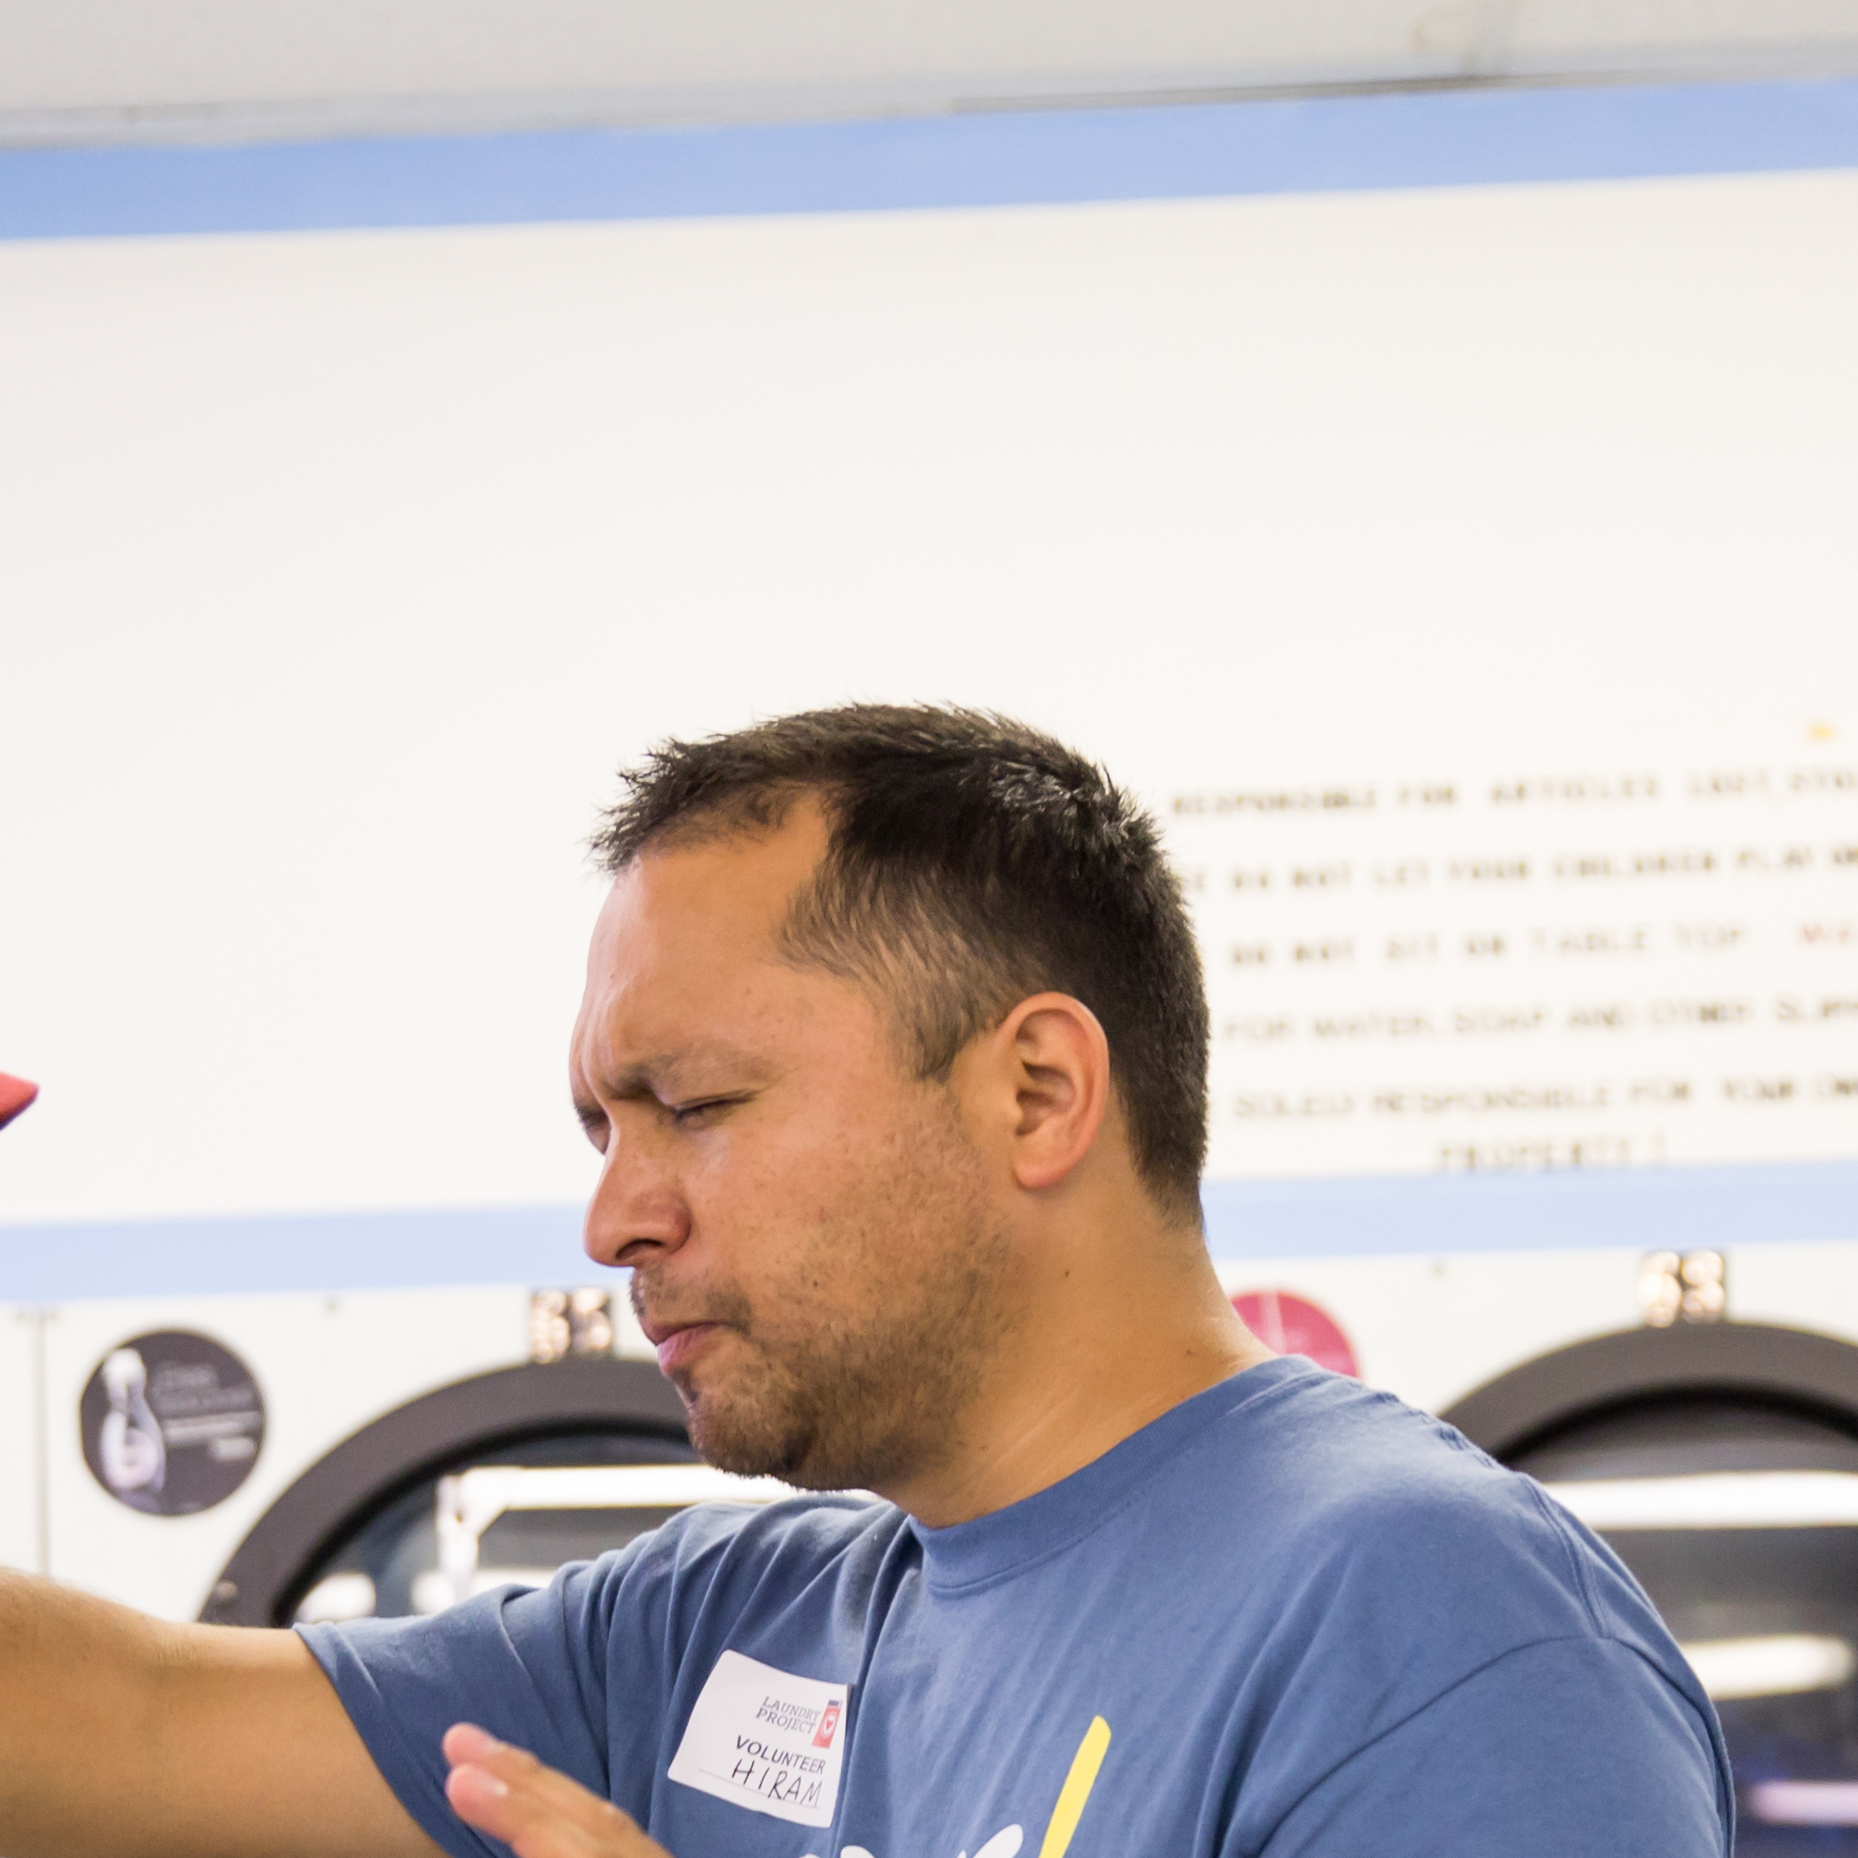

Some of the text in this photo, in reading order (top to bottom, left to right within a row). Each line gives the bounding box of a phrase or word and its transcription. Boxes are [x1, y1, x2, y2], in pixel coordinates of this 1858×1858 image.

[1396, 779, 1460, 811] FOR
[1489, 770, 1662, 808] ARTICLES
[1289, 857, 1355, 891] NOT
[1289, 933, 1355, 968] NOT
[1531, 922, 1652, 957] TABLE
[755, 1706, 817, 1735] PROJECT
[761, 1695, 822, 1721] LAUNDRY
[735, 1734, 827, 1776] VOLUNTEER
[730, 1757, 824, 1809] HIRAM
